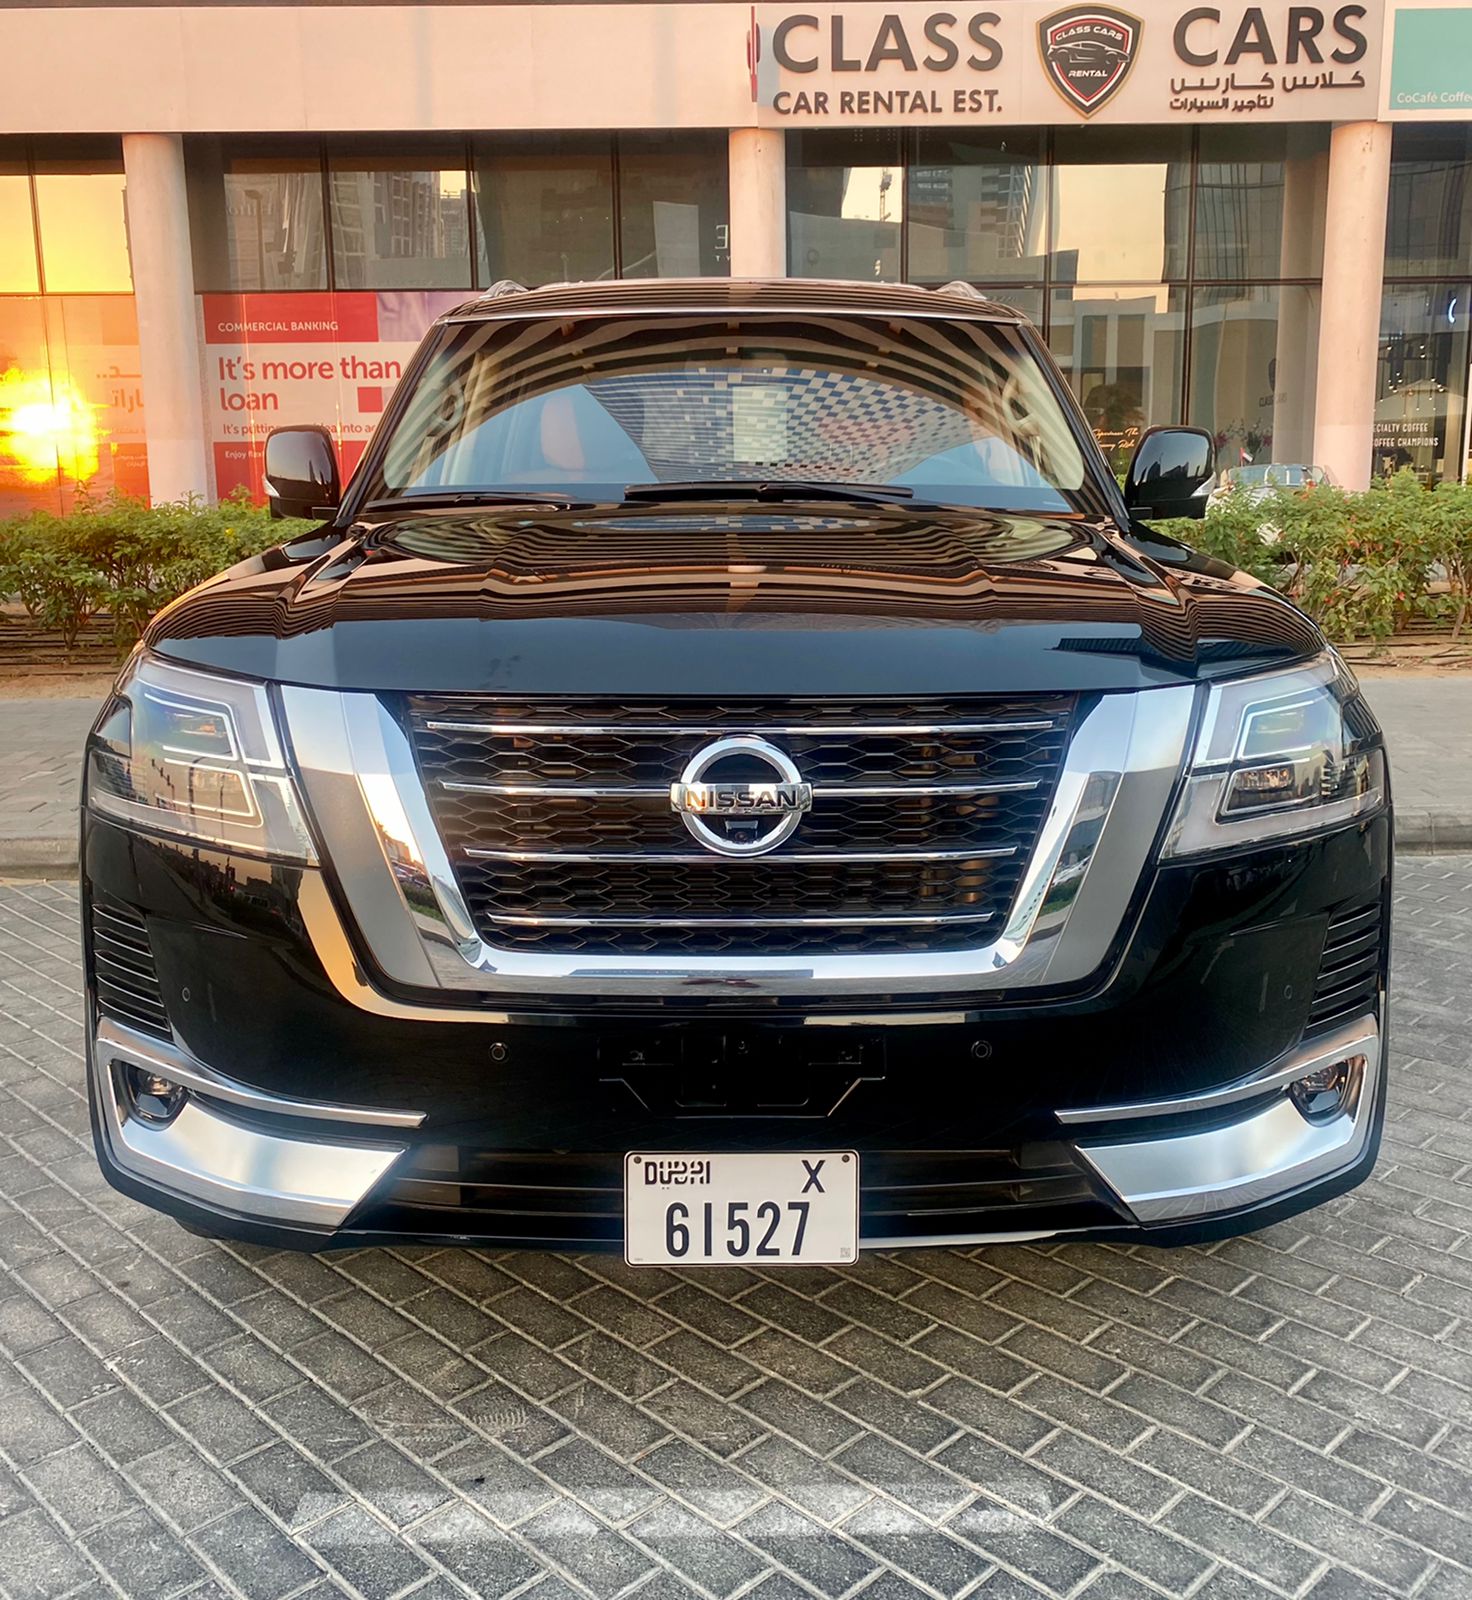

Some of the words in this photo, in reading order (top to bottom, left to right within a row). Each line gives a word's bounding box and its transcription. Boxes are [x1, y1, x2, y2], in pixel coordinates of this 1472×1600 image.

[1055, 25, 1091, 41] CLASS
[1093, 26, 1124, 41] CARS
[1172, 4, 1367, 67] CARS
[772, 12, 1003, 73] CLASS
[1068, 69, 1108, 78] RENTAL
[772, 91, 829, 115] CAR
[840, 90, 943, 114] RENTAL
[953, 89, 1003, 113] EST.
[1169, 96, 1230, 113] السيارات
[1396, 91, 1438, 104] CoCafé
[1440, 91, 1472, 103] Coffe
[217, 322, 289, 333] COMMERCIAL
[291, 321, 339, 332] BANKING
[262, 361, 334, 380] more
[339, 355, 401, 380] than
[220, 387, 279, 411] loan
[1373, 424, 1400, 433] ECIALTY
[1402, 423, 1429, 433] COFFEE
[1374, 437, 1396, 448] OFFEE
[1397, 437, 1439, 447] CHAMPIONS
[686, 790, 797, 808] NISSAN
[801, 1159, 826, 1194] X
[665, 1201, 810, 1258] 61527
